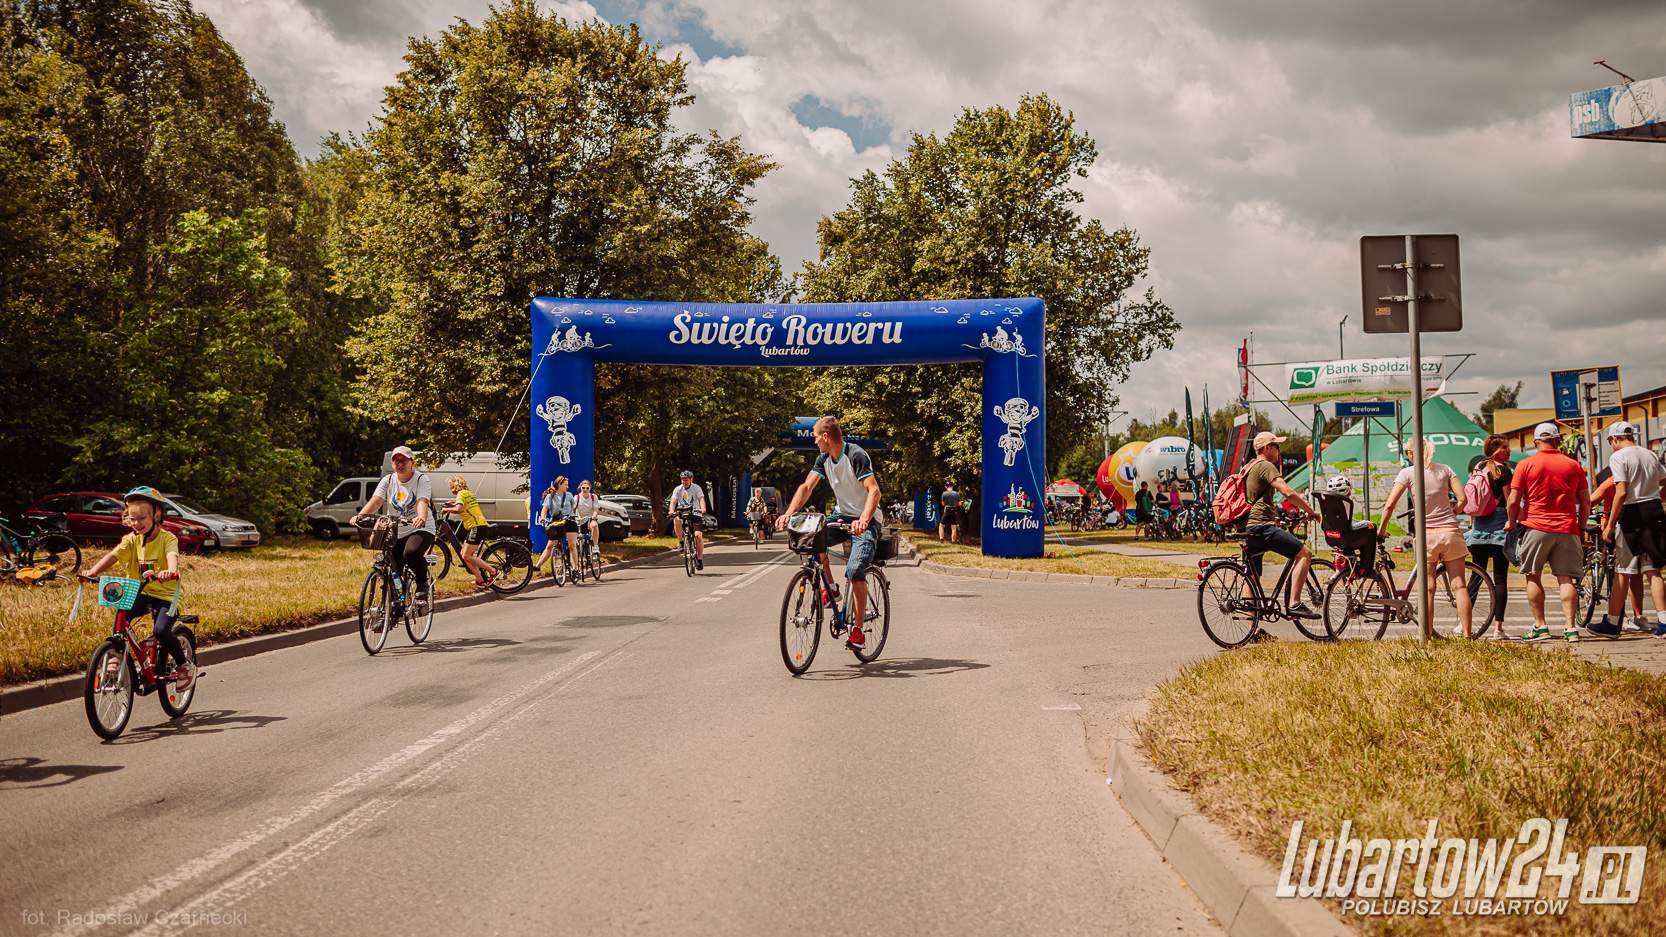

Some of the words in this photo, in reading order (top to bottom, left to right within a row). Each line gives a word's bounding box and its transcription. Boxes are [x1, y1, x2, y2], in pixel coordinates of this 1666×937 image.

[669, 310, 774, 349] Święto
[782, 314, 903, 346] Roweru
[759, 345, 811, 357] Lubartów
[1326, 363, 1358, 375] Bank
[1361, 361, 1443, 376] Spółdziczy
[992, 514, 1039, 529] Lubartów
